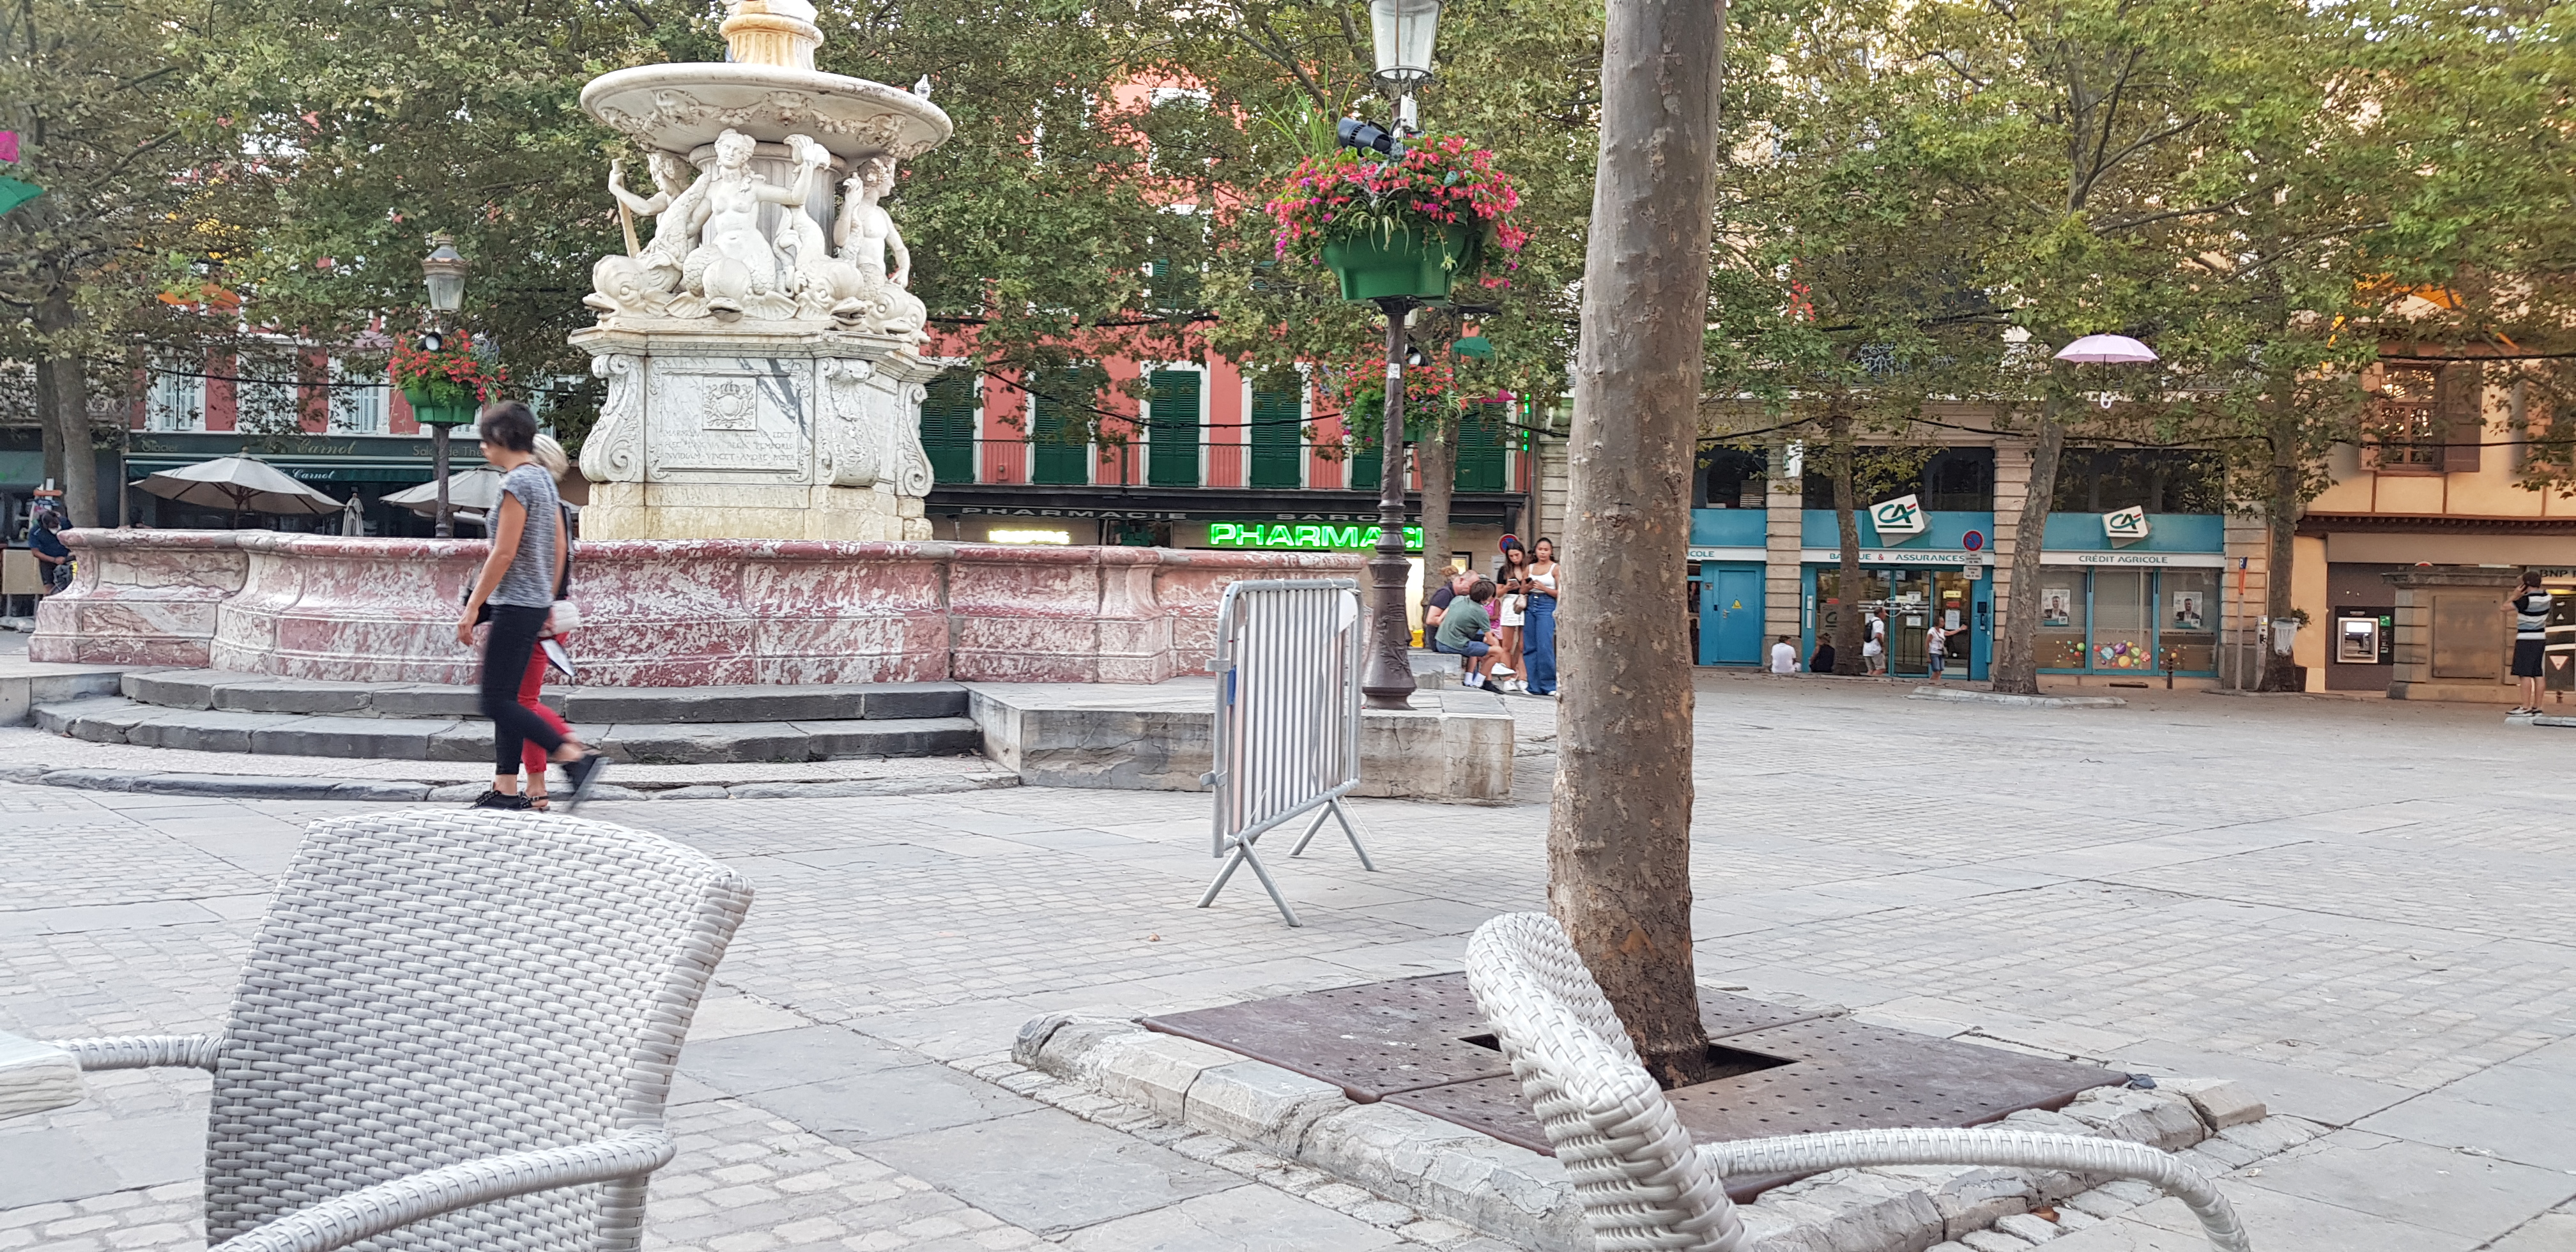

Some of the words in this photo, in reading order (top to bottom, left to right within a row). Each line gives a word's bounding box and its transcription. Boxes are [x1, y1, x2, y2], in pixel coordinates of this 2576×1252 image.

[296, 438, 356, 455] Carnot
[292, 468, 335, 479] Carnot
[962, 507, 1187, 519] PHARMACIE
[1878, 503, 1917, 524] CA
[2110, 513, 2142, 530] CA
[1210, 523, 1424, 548] PHARMACI
[1895, 554, 1965, 562] ASSURANCES
[2078, 554, 2114, 563] CRÉDIT
[2117, 556, 2168, 564] AGRICOLE
[2539, 569, 2568, 577] BNP
